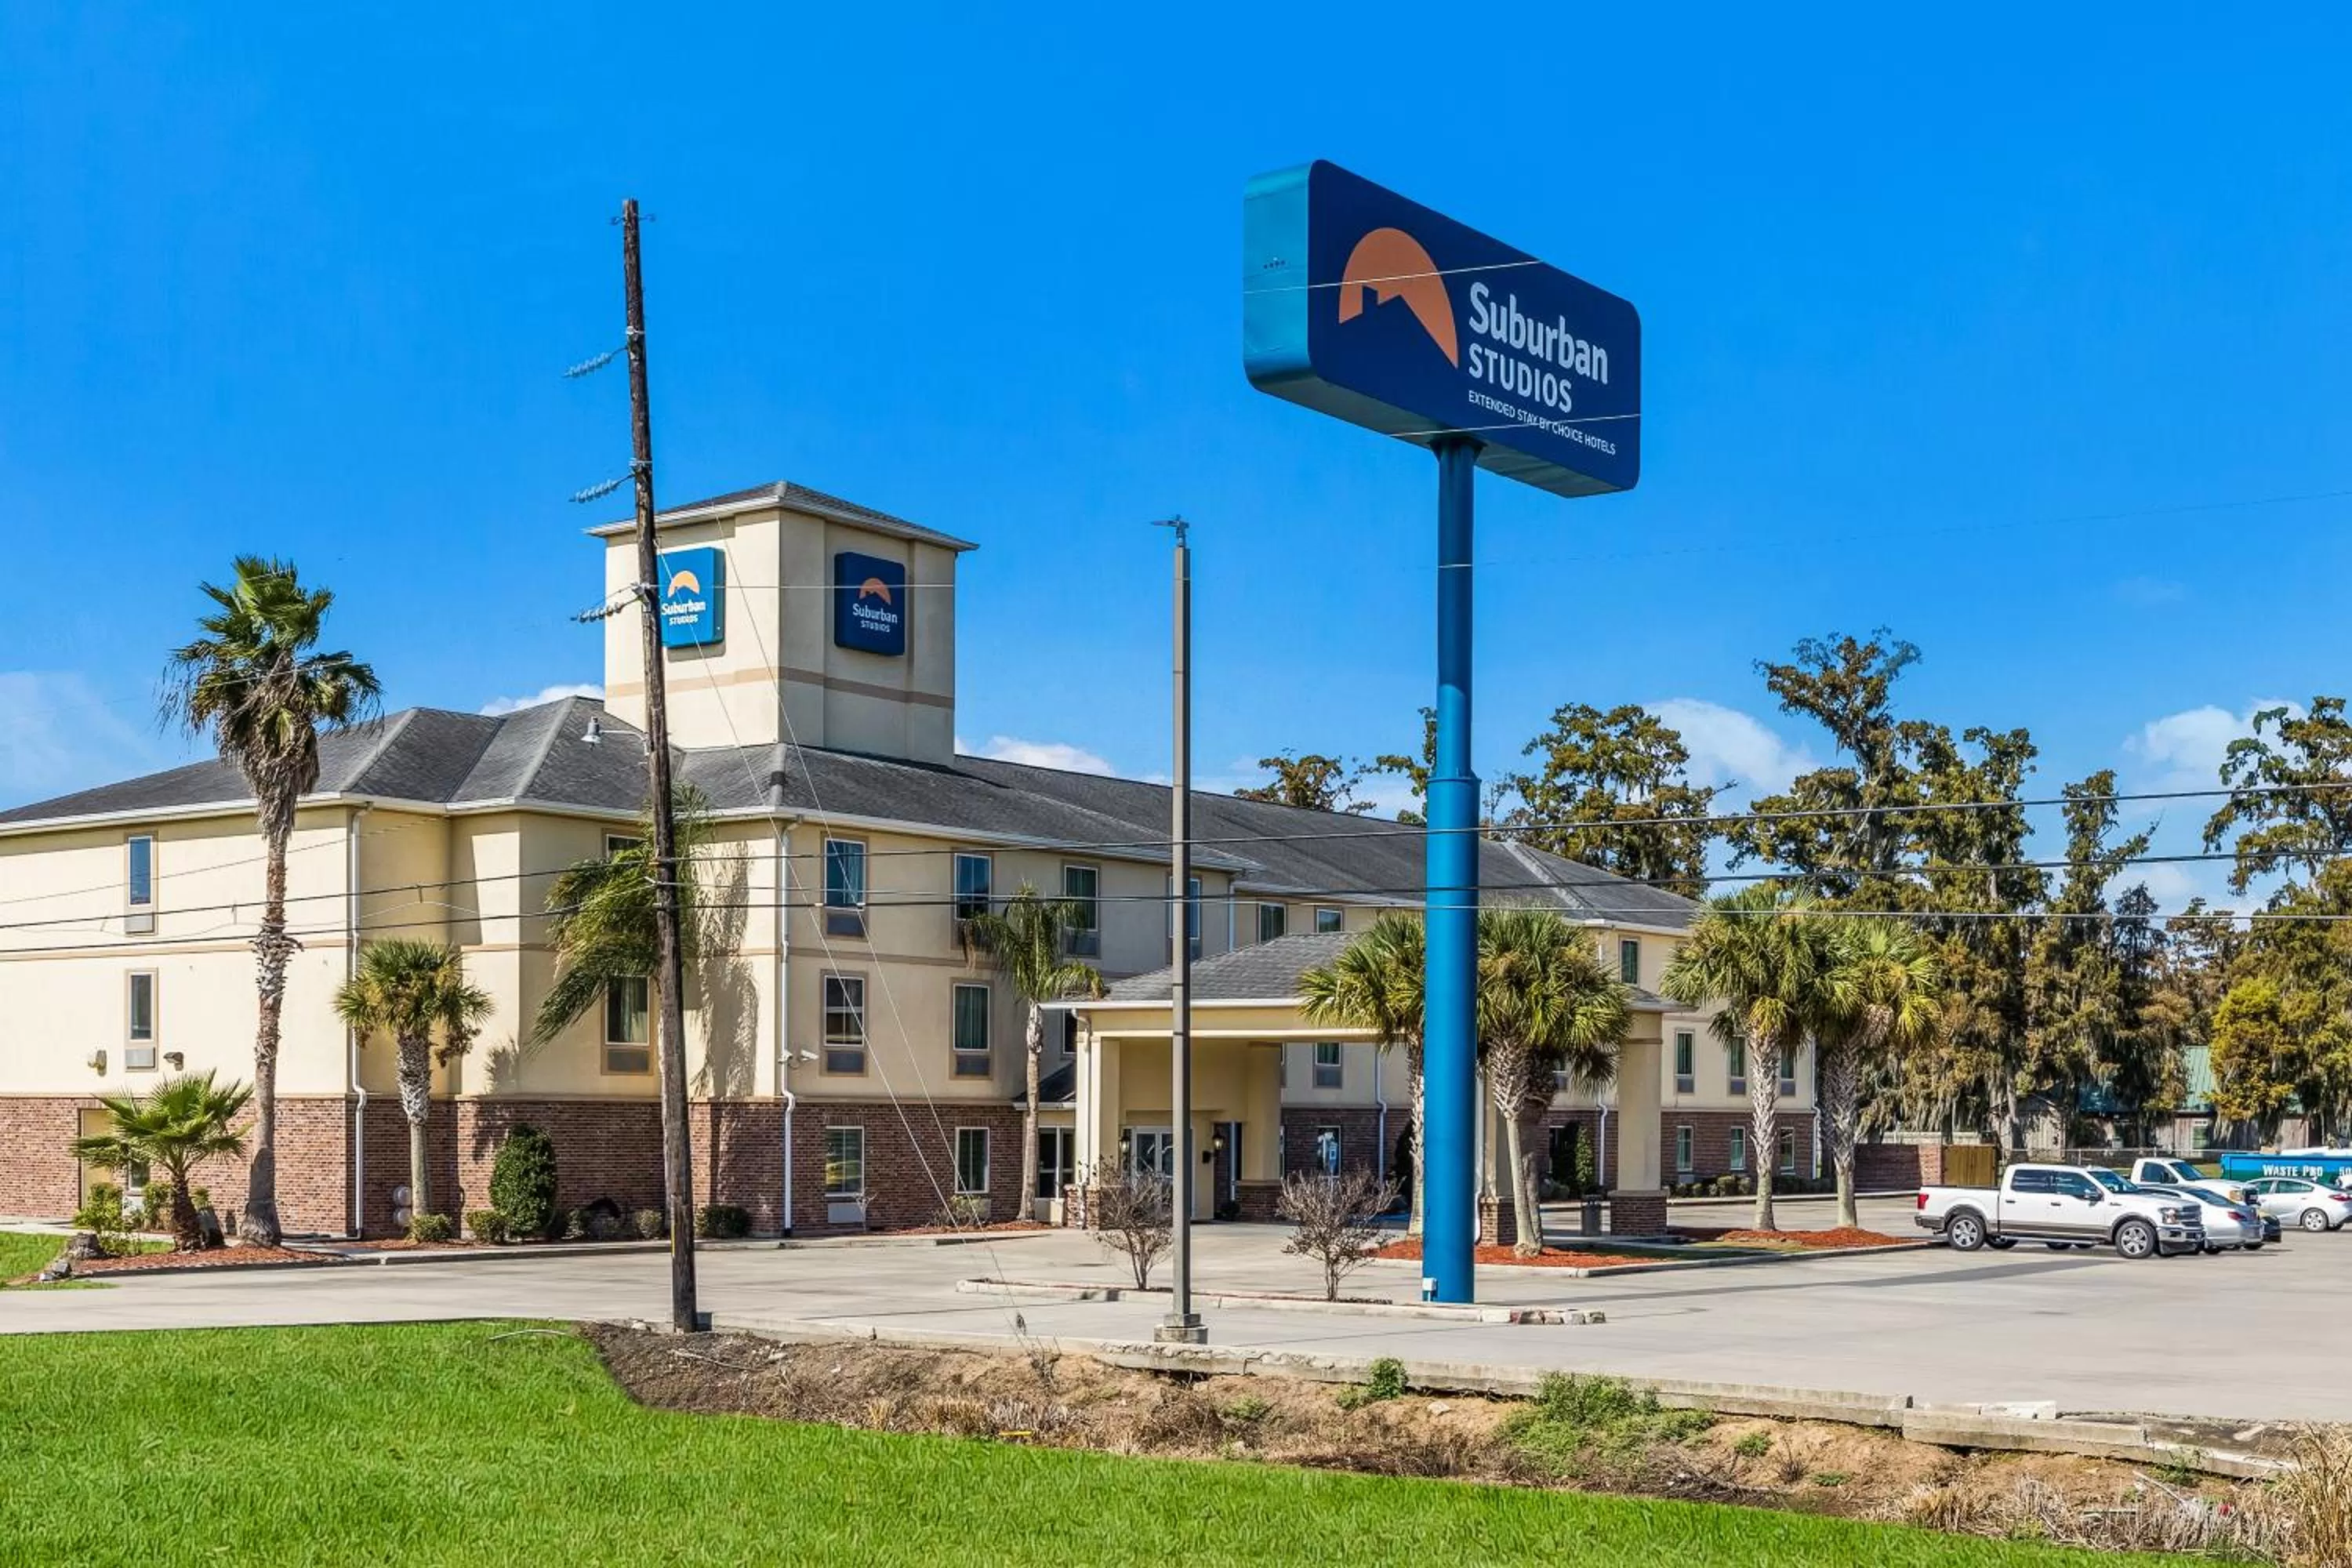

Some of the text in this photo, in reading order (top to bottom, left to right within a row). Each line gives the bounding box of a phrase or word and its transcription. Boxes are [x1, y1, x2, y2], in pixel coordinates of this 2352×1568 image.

[1468, 281, 1608, 385] Suburban
[1468, 343, 1573, 413] STUDIOS
[1468, 390, 1616, 455] EXTENDED STAY BY CHOICE HOTELS
[661, 599, 706, 615] Suburban
[852, 603, 898, 624] Suburban
[860, 619, 891, 633] STUDIOS
[2263, 1163, 2323, 1177] WASTE PRO
